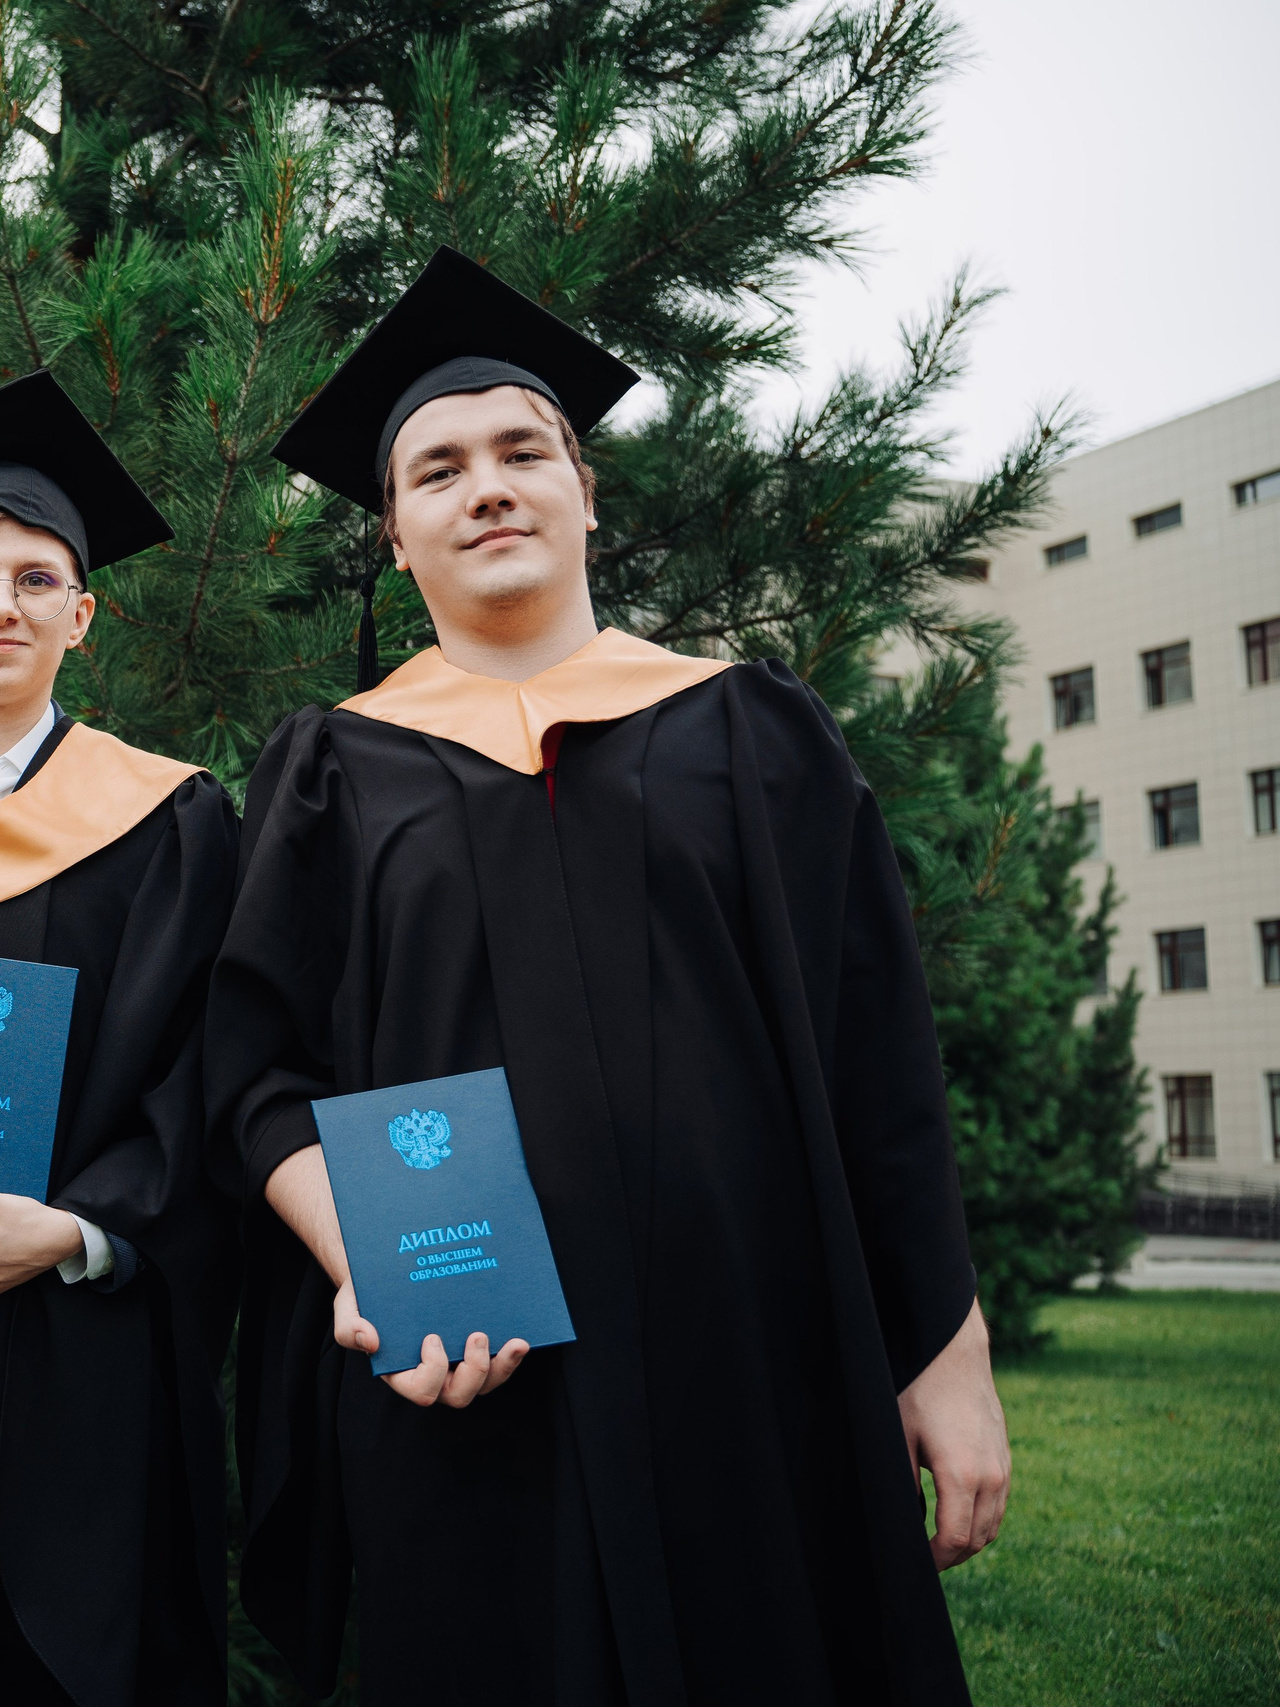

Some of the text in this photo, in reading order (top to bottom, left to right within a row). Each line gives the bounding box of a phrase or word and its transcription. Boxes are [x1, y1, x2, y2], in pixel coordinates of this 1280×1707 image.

[398, 1219, 492, 1253] ДИПЛОМ
[416, 1246, 483, 1266] О ВЫСШЕМ
[409, 1257, 498, 1282] ОБРАЗОВАНИИ
